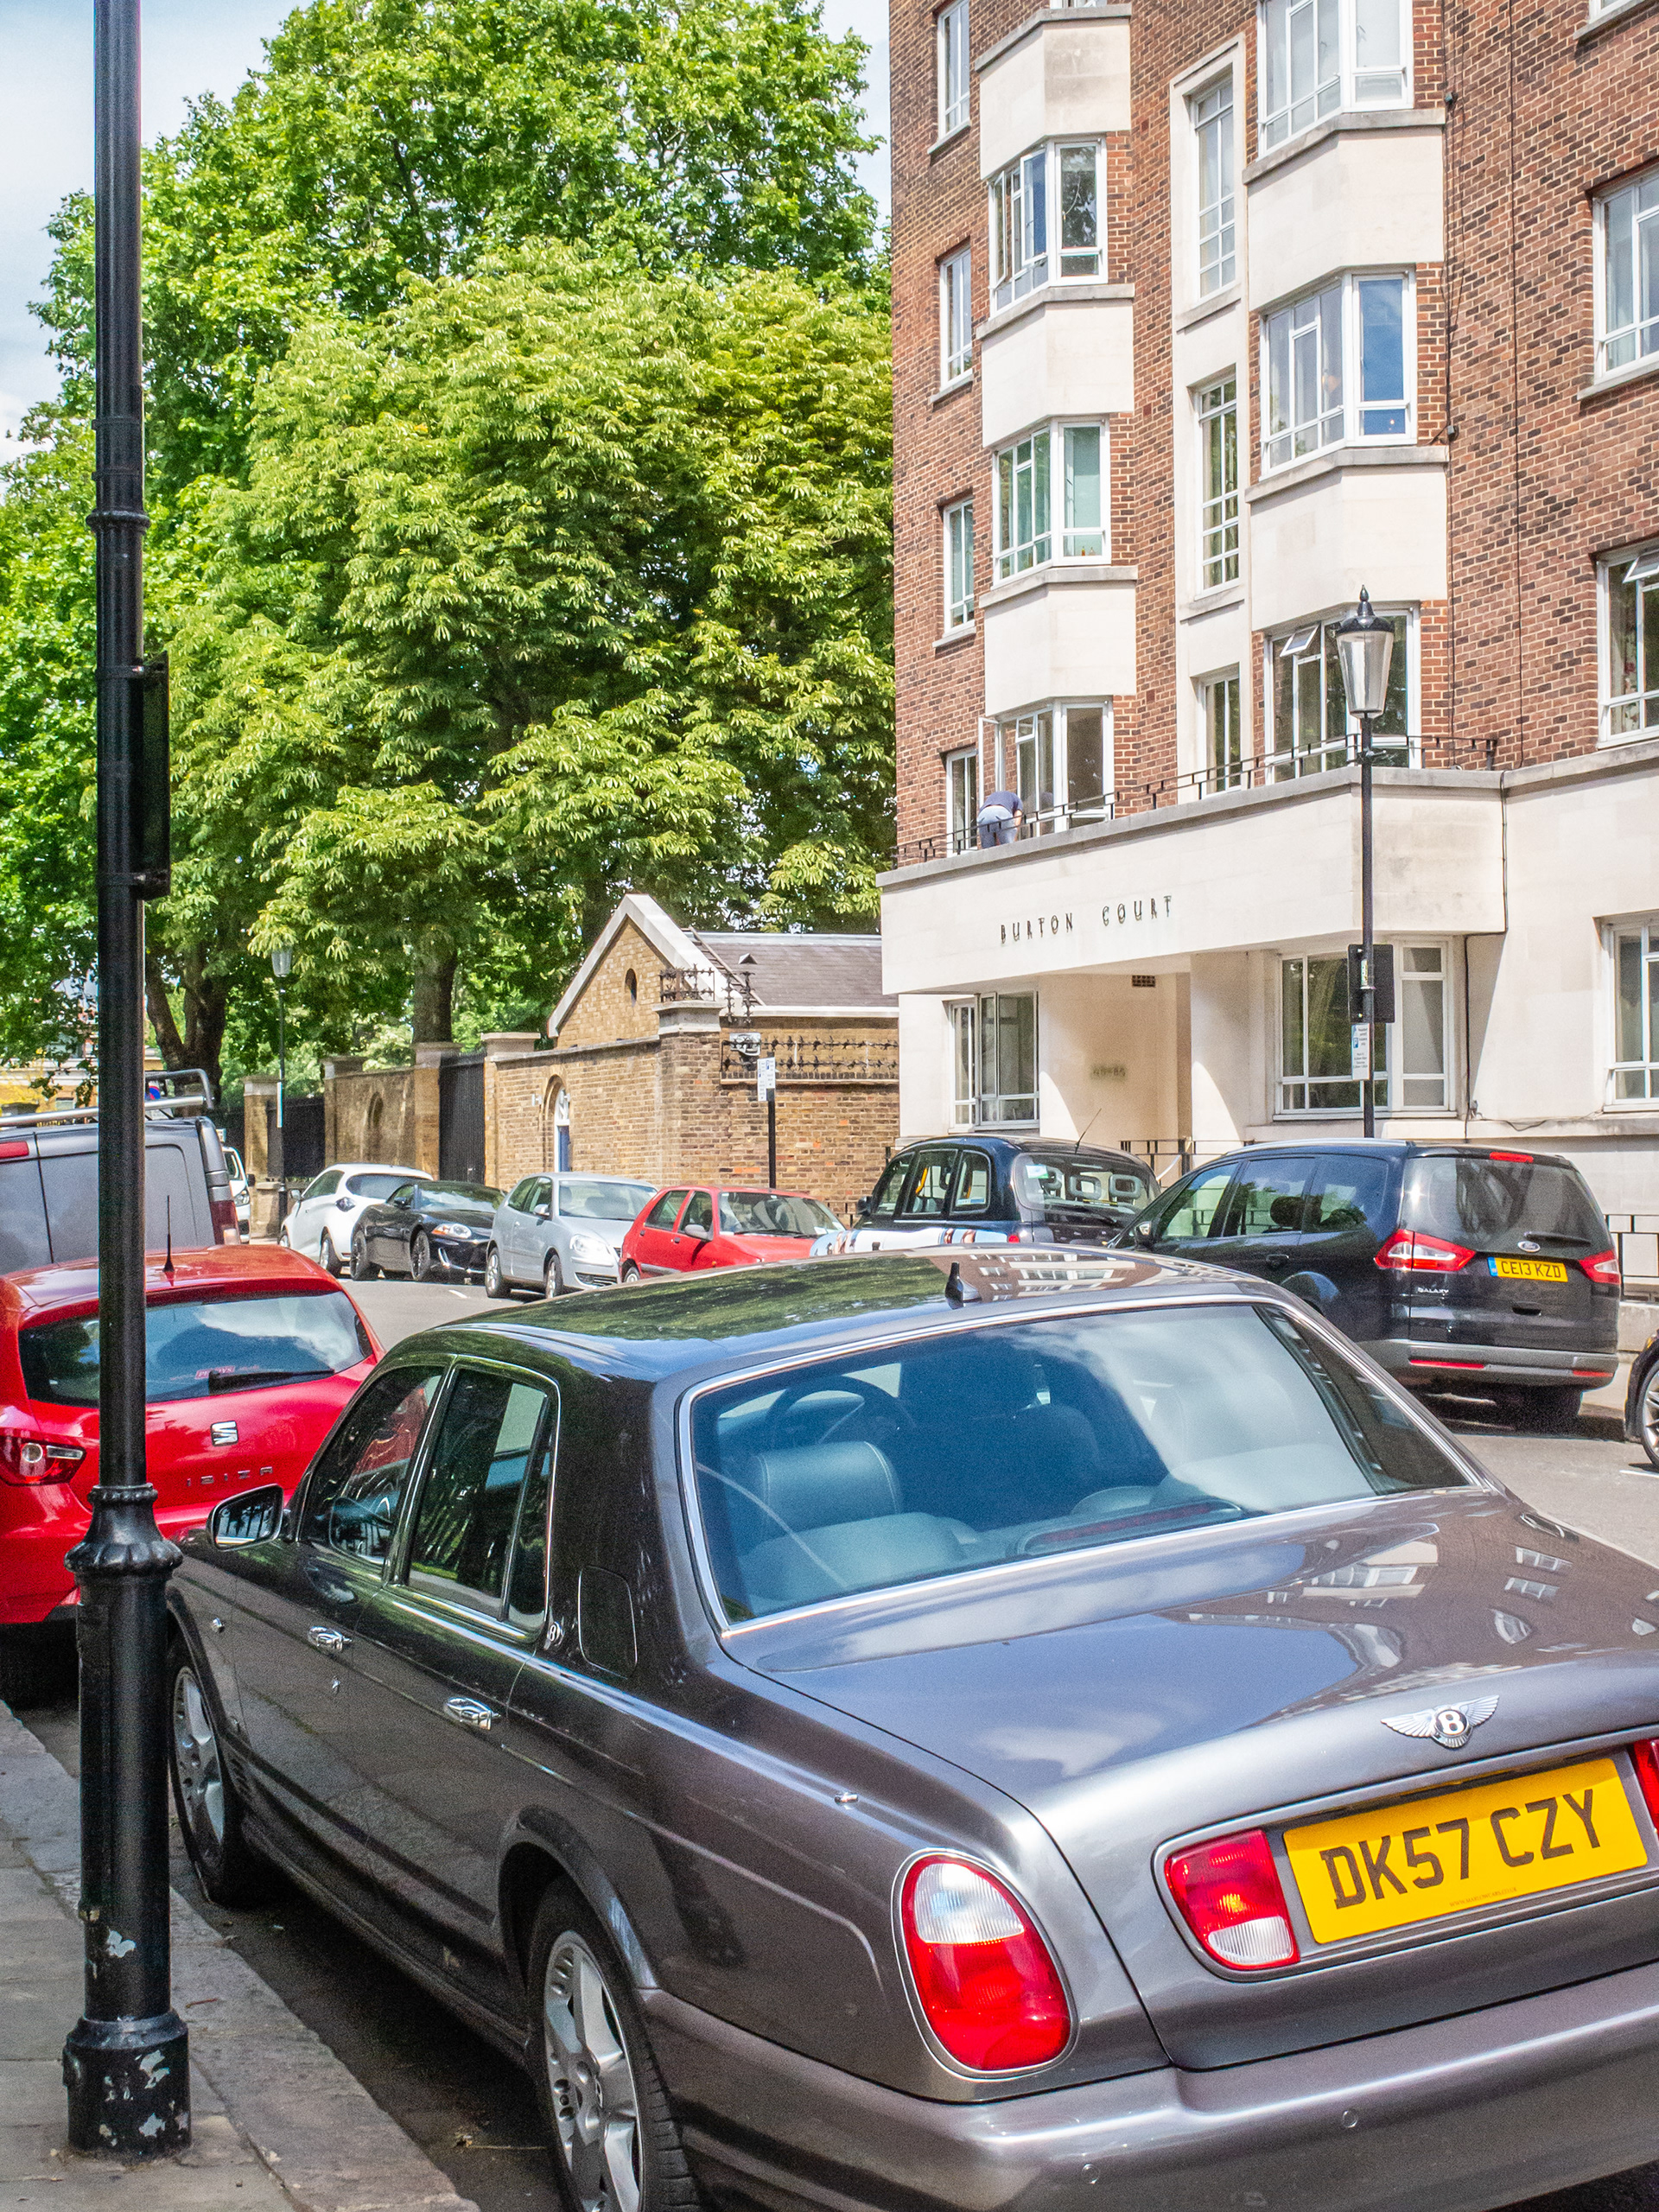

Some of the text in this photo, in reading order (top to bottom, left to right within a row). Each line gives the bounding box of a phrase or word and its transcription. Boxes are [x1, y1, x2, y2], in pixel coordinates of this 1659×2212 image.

[1001, 895, 1172, 944] BURTON COURT
[1501, 1261, 1561, 1278] CE13 KZD
[187, 1466, 273, 1486] IBIZA
[1441, 1714, 1465, 1735] B
[1319, 1789, 1601, 1910] DK57 CZY
